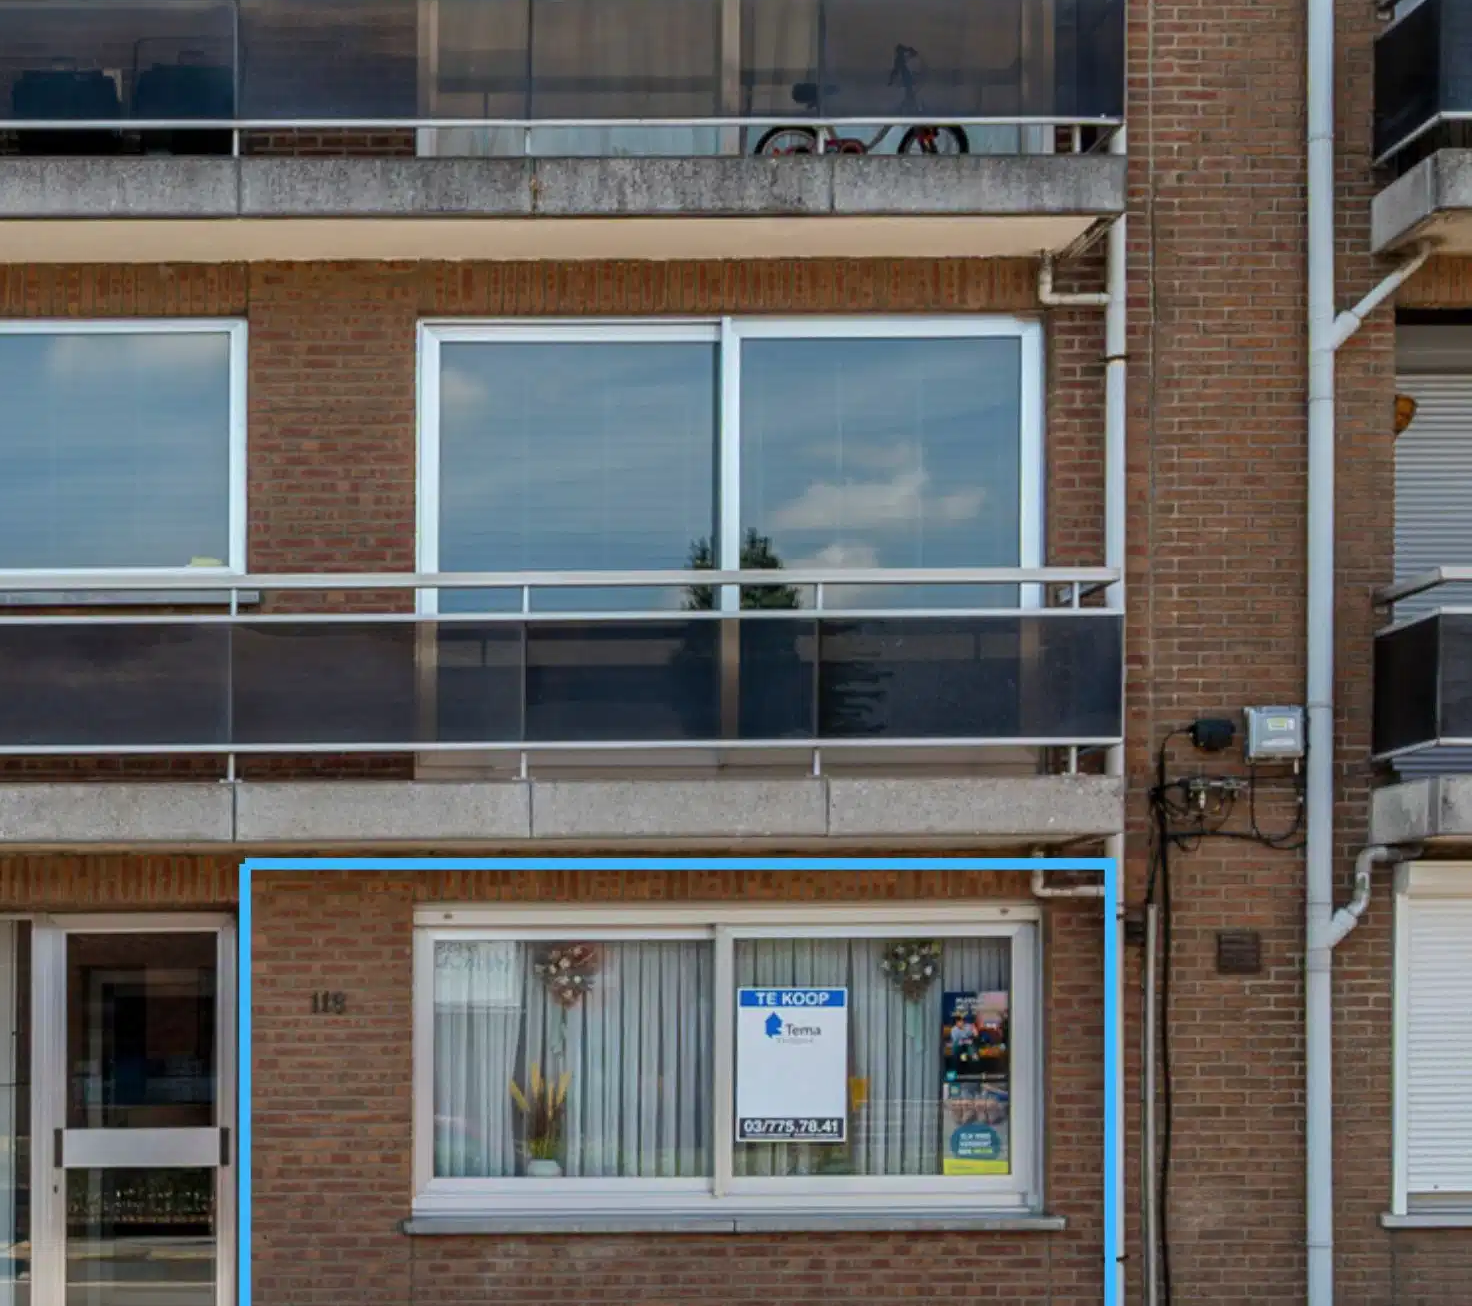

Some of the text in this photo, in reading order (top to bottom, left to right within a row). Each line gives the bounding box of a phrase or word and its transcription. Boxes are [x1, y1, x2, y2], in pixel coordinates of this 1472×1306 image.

[756, 992, 830, 1005] TE KOOP
[786, 1023, 822, 1036] Tema
